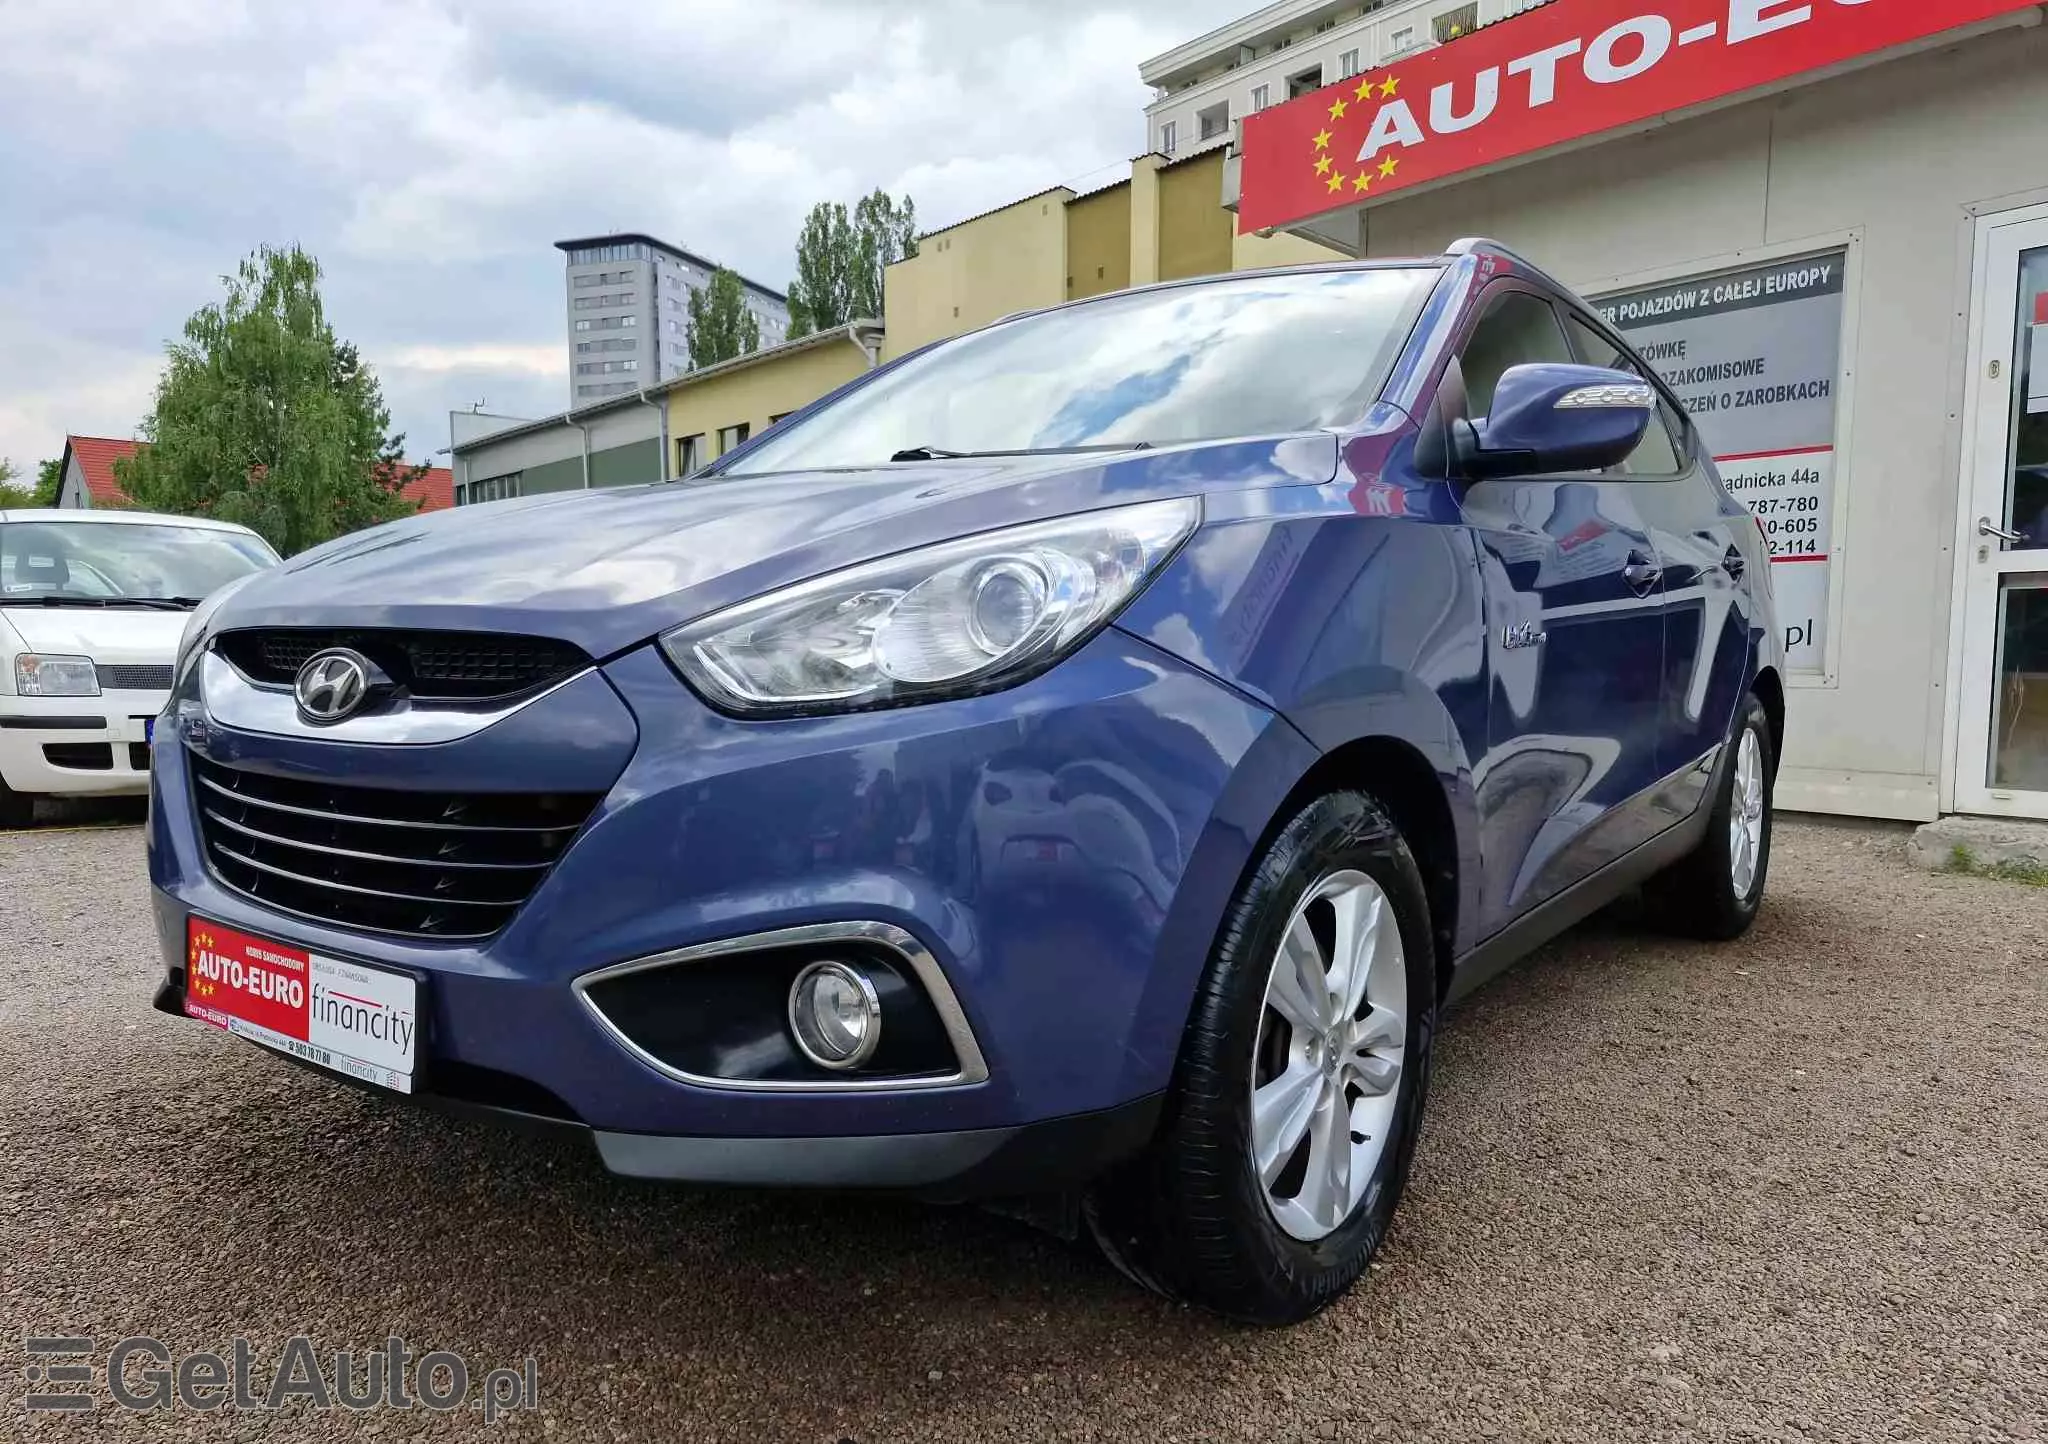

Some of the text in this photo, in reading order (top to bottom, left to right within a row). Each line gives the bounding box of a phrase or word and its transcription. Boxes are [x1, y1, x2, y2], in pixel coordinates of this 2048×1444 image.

[1355, 0, 1872, 164] AUTO-E
[1620, 290, 1697, 321] POJAZDÓW
[1700, 289, 1710, 306] Z
[1713, 277, 1761, 304] CAŁEJ
[1765, 264, 1831, 295] EUROPY
[1721, 392, 1732, 410] O
[1735, 379, 1830, 408] ZAROBKACH
[1791, 468, 1820, 485] 44a
[1748, 496, 1818, 515] 787-780
[1763, 517, 1817, 535] 0-605
[1769, 539, 1816, 555] 2-114
[197, 950, 304, 1009] AUTO-EURO
[189, 1004, 227, 1026] AUTO-EURO
[312, 982, 414, 1055] financity
[341, 1055, 378, 1082] financity
